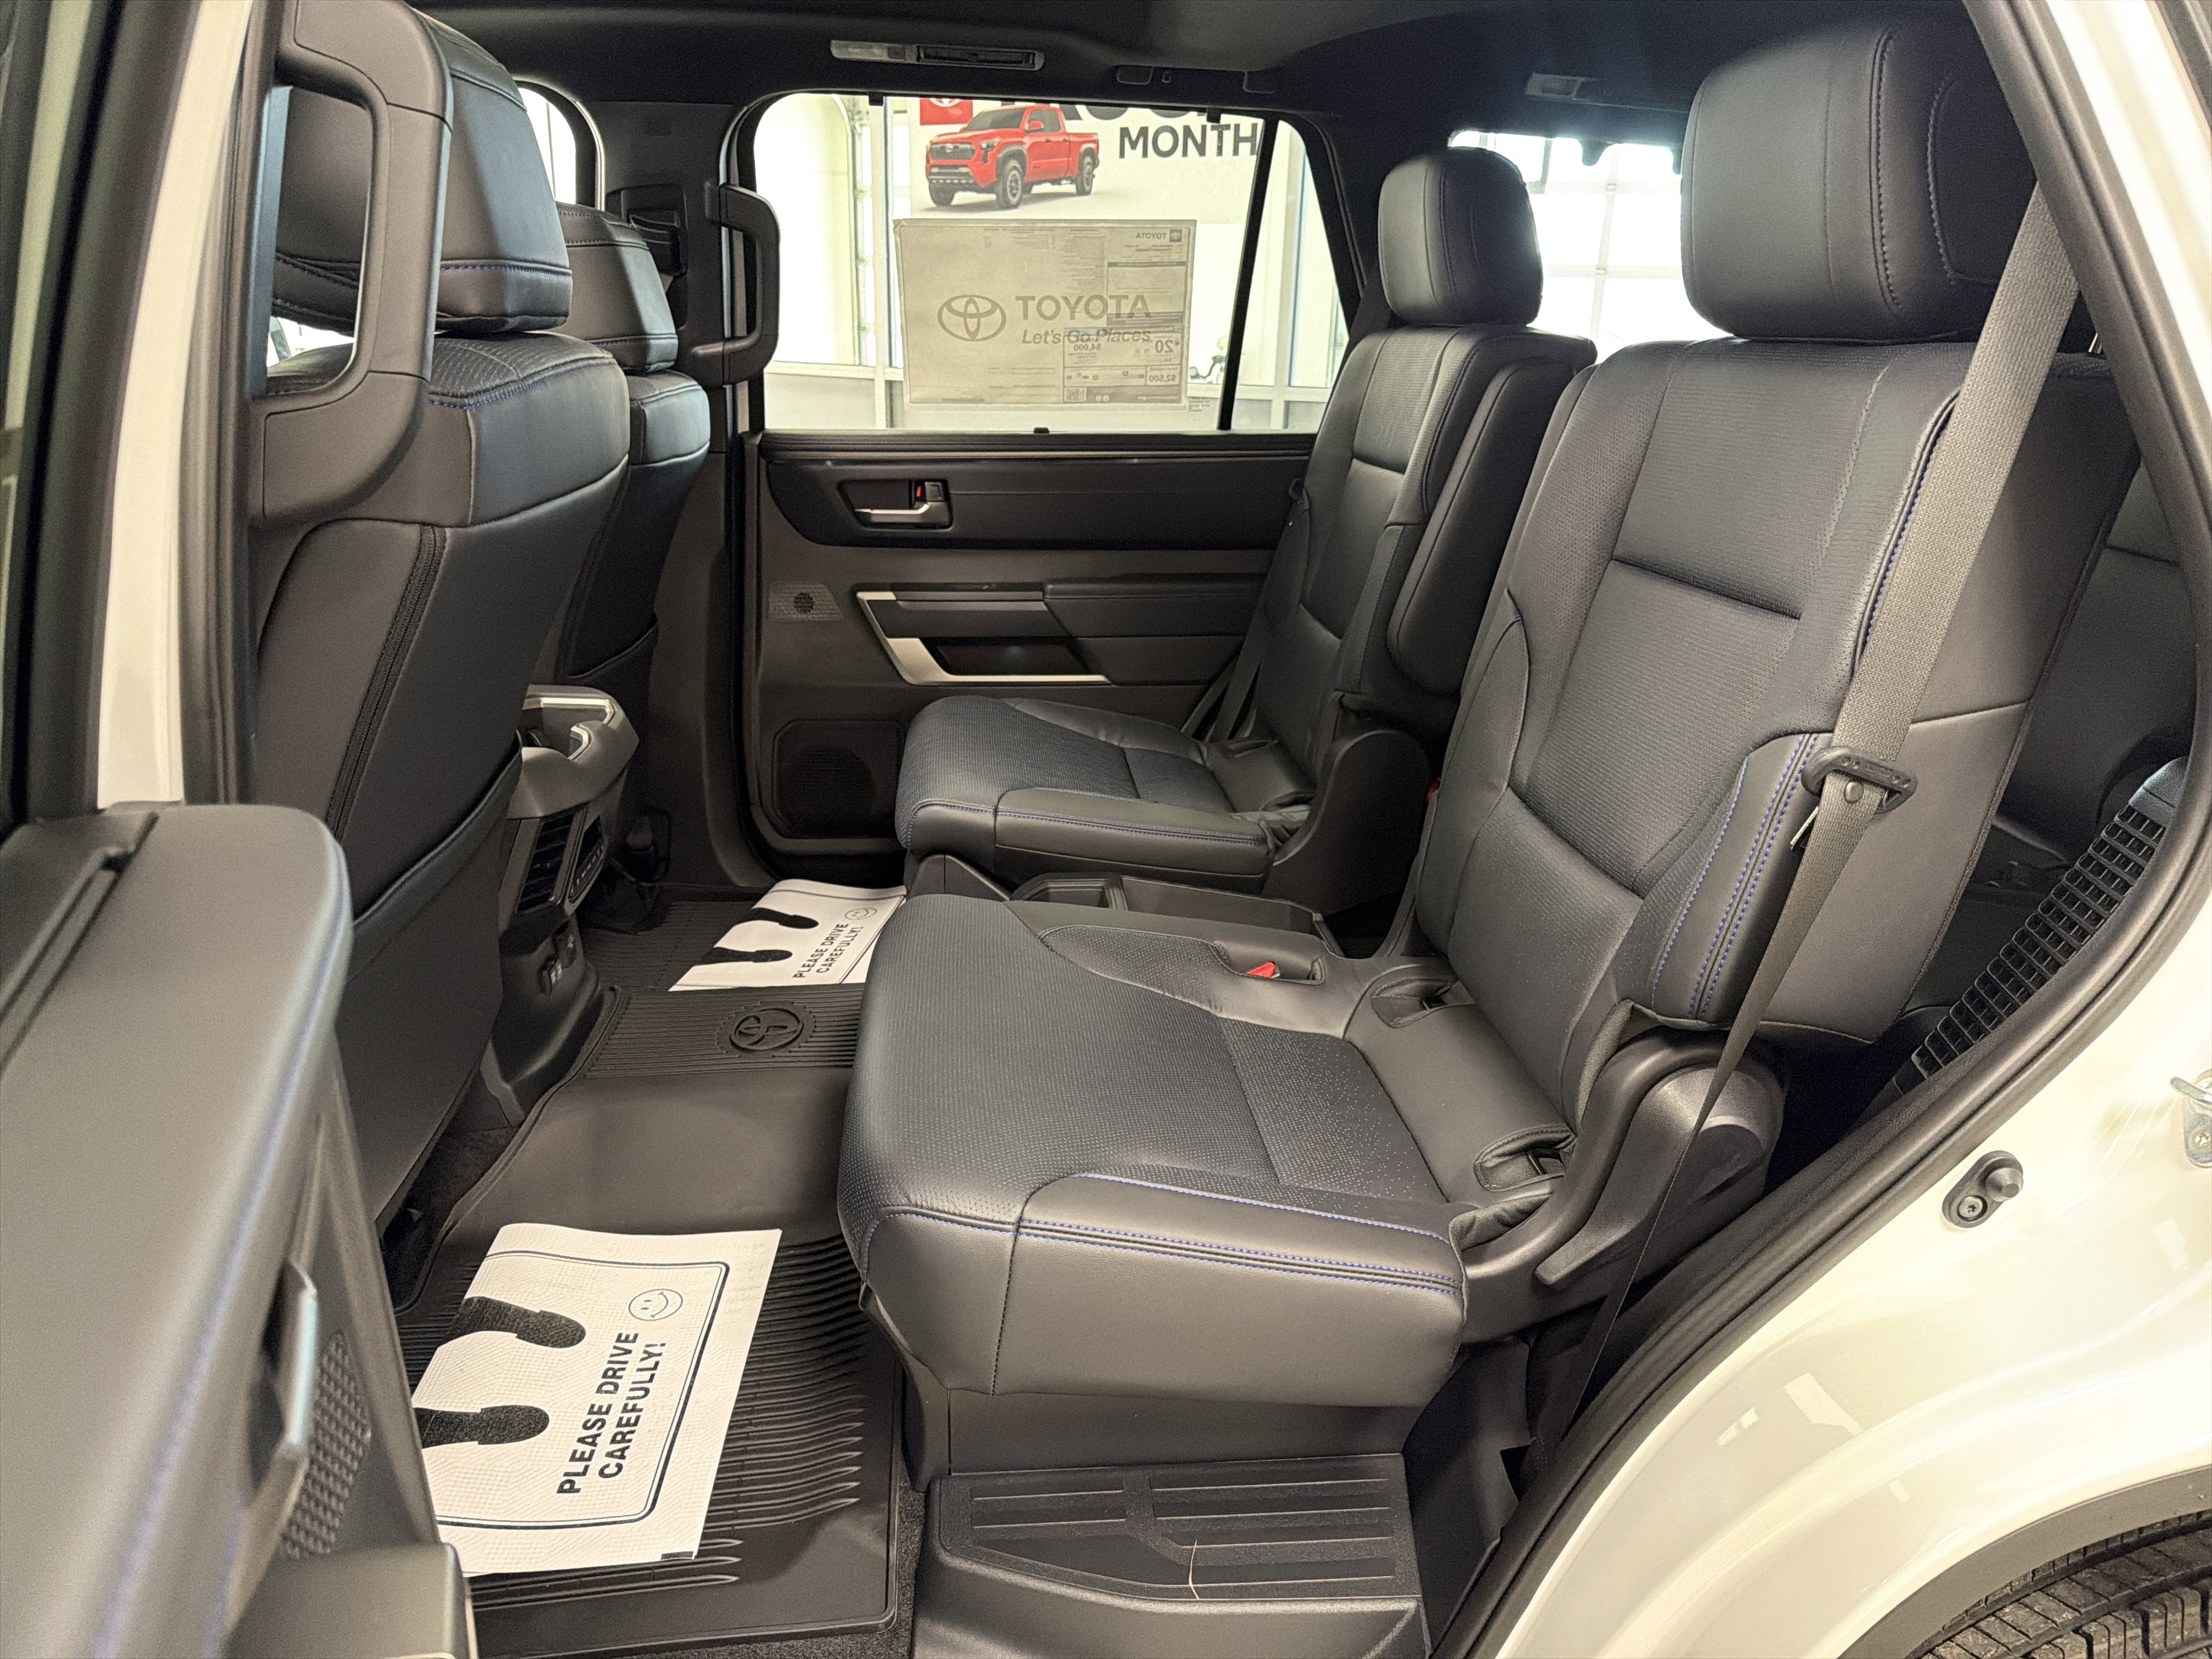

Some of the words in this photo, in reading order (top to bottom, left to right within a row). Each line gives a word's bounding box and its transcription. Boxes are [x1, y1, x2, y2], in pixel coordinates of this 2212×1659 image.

[1119, 123, 1257, 159] MONTH
[1015, 295, 1152, 321] TOYOTA
[1022, 329, 1062, 345] Let's
[792, 948, 829, 978] PLEASE
[820, 923, 849, 946] DRIVE
[815, 926, 864, 973] CAREFULLY!
[556, 1403, 613, 1494] PLEASE
[595, 1332, 640, 1395] DRIVE
[598, 1342, 667, 1479] CAREFULLY!
